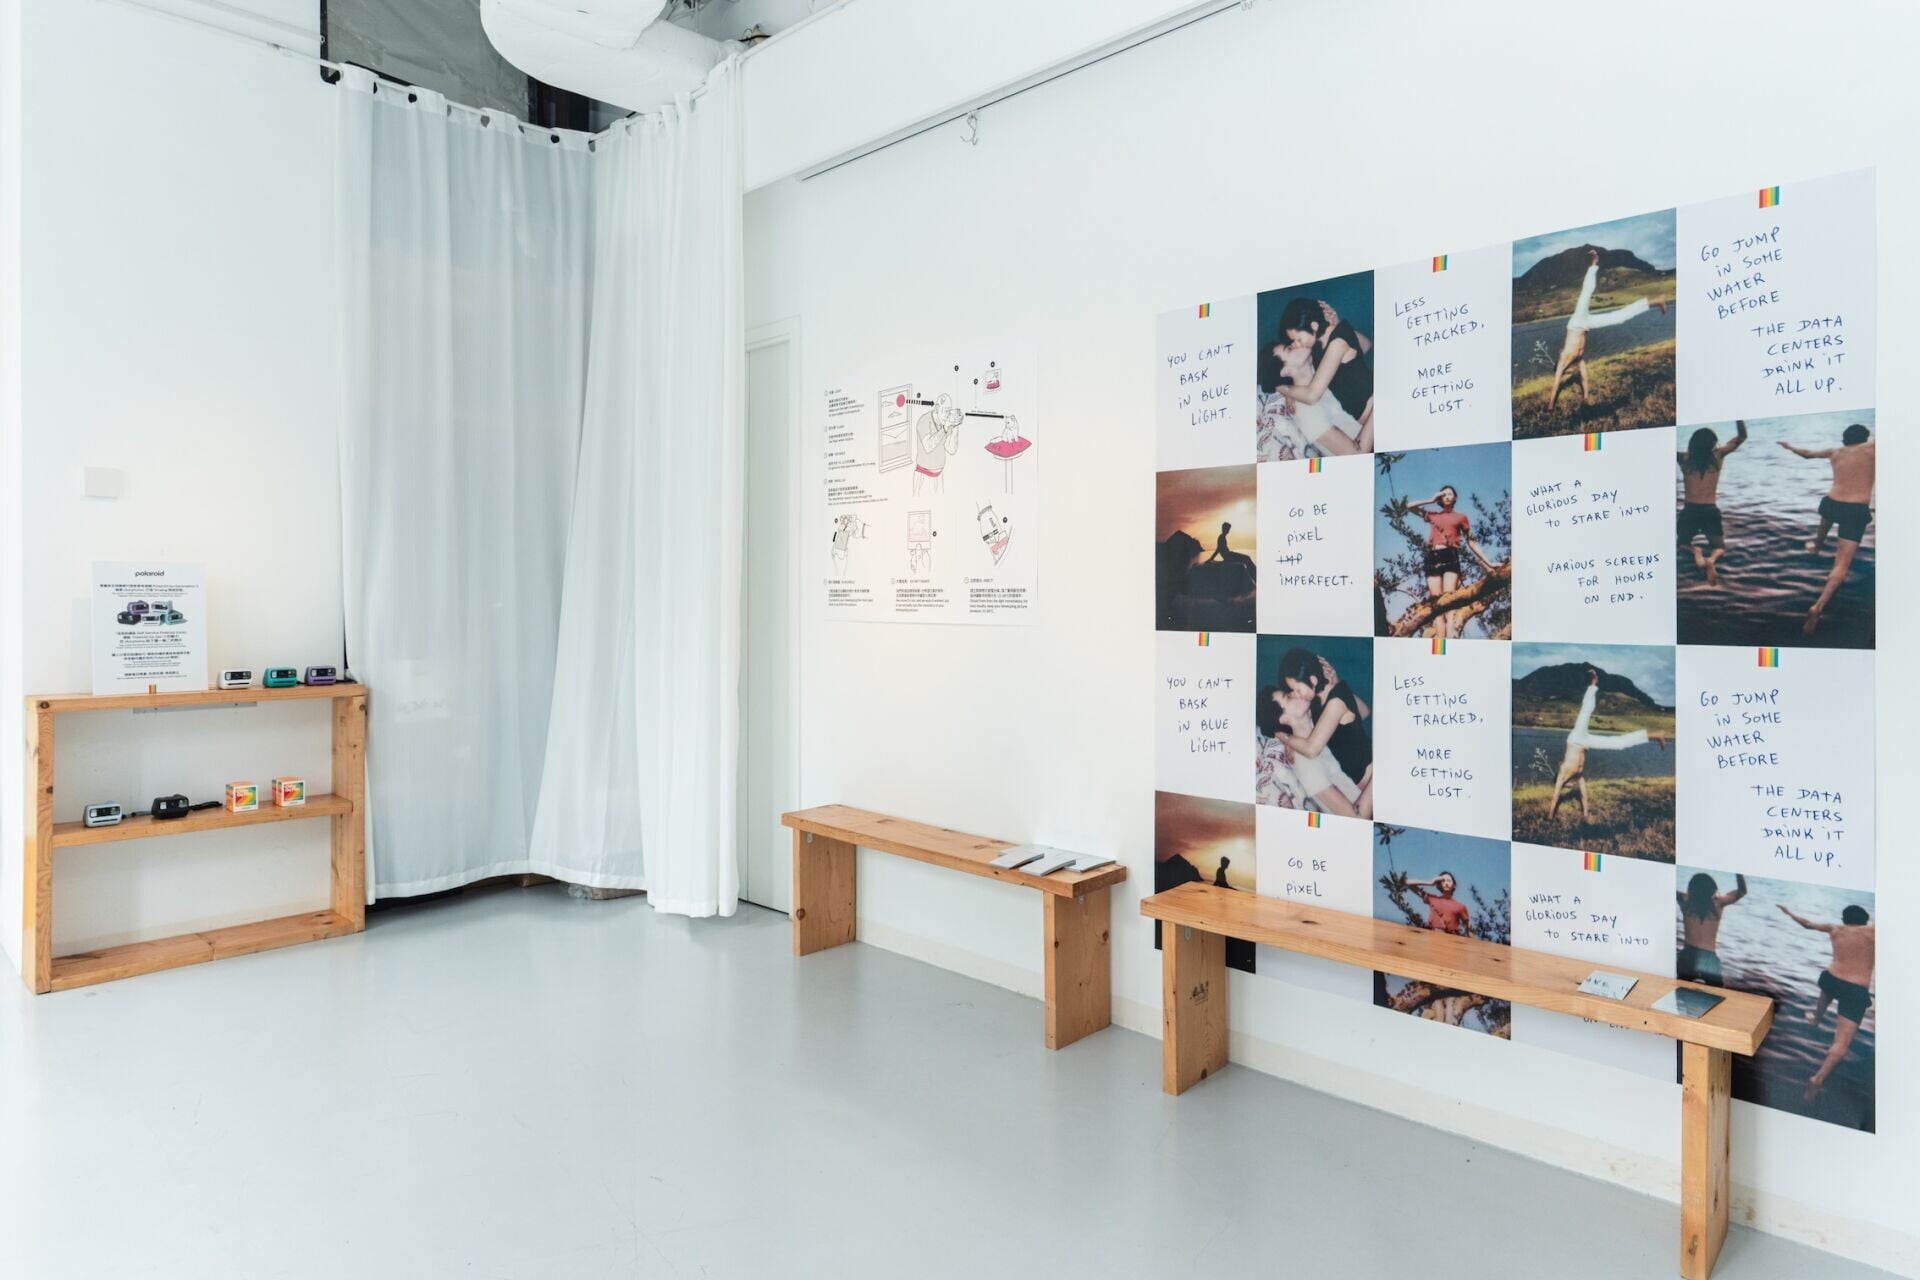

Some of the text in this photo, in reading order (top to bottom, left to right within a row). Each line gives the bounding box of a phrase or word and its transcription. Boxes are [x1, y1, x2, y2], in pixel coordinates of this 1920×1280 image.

[1701, 226, 1780, 262] GO JUMP
[1742, 248, 1784, 269] SOME
[1707, 272, 1766, 301] WATER
[1394, 296, 1426, 318] LESS
[1717, 290, 1780, 320] BEFORE
[1406, 303, 1469, 330] GETTING
[1413, 320, 1485, 347] TRACKED.
[1751, 315, 1843, 337] THE DATA
[1767, 334, 1844, 356] CENTERS
[1167, 343, 1234, 368] YOU CAN'T
[1180, 367, 1209, 385] BASK
[1417, 362, 1453, 379] MORE
[1762, 357, 1815, 378] DRINK
[1201, 383, 1230, 401] BLUE
[1411, 378, 1474, 399] GETTING
[1775, 377, 1843, 396] ALL UP.
[1529, 479, 1582, 498] WHAT A
[1289, 503, 1328, 518] GO BE
[1526, 489, 1618, 516] GLORIOUS DAY
[1571, 510, 1611, 526] STARE
[1547, 553, 1660, 574] VARIOUS SCREENS
[1279, 572, 1353, 587] IMPERFECT.
[1577, 571, 1654, 588] FOR HOURS
[1584, 592, 1644, 605] ON END.
[1167, 677, 1233, 690] YOU CAN'T
[1394, 675, 1425, 691] LESS
[1179, 697, 1208, 710] BASK
[1406, 693, 1468, 708] GETTING
[1700, 688, 1779, 707] GO JUMP
[1200, 718, 1229, 731] BLUE
[1413, 712, 1483, 727] TRACKED.
[1742, 711, 1783, 725] SOME
[1706, 730, 1766, 749] WATER
[1416, 748, 1452, 760] MORE
[1717, 752, 1780, 770] BEFORE
[1411, 766, 1473, 781] GETTING
[1750, 784, 1843, 804] THE DATA
[1766, 806, 1843, 822] CENTERS
[1761, 824, 1814, 840] DRINK
[1288, 856, 1327, 872] GO BE
[1774, 844, 1842, 868] ALL UP.
[1528, 893, 1581, 905] WHAT A
[1525, 909, 1617, 929] GLORIOUS DAY
[1571, 931, 1610, 943] STARE
